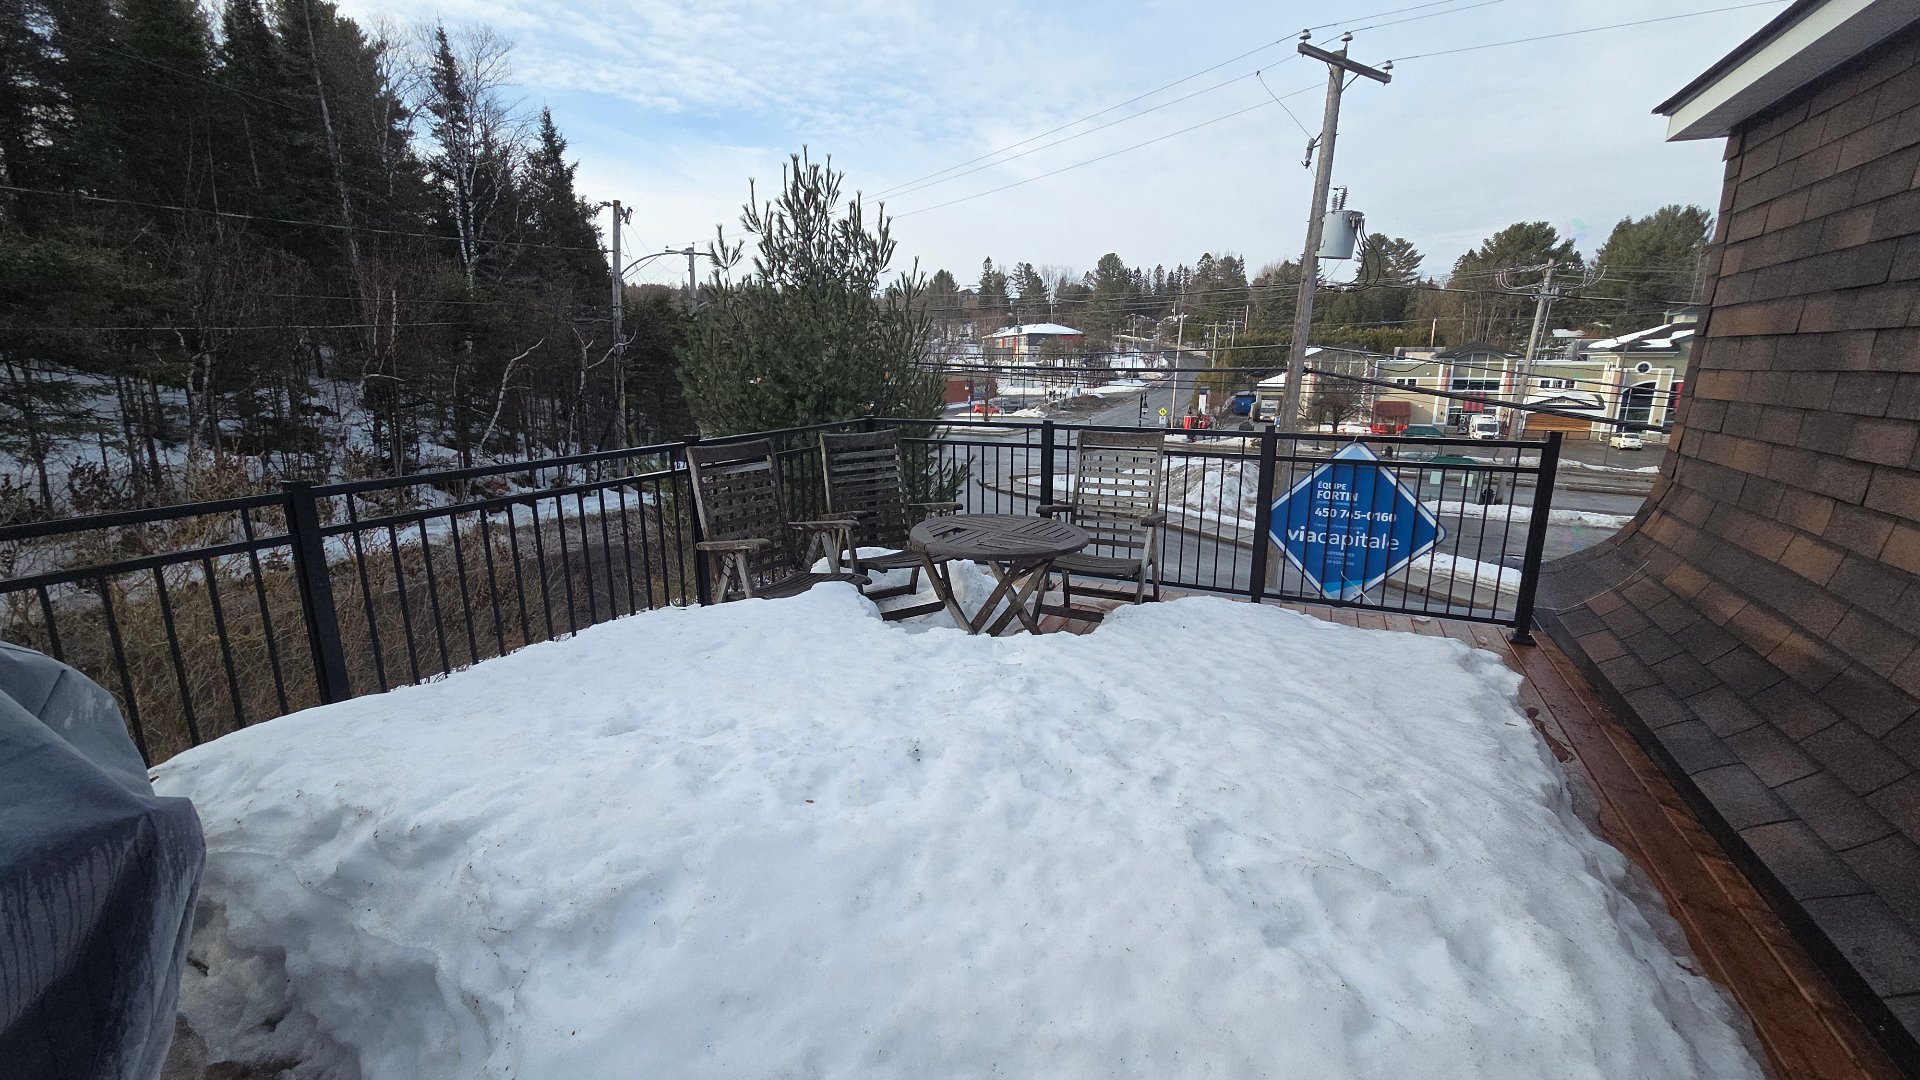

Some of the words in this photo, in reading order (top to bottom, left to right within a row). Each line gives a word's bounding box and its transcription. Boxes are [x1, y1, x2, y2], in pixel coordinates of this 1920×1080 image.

[1316, 490, 1358, 501] FORTIN
[1314, 507, 1337, 518] 450
[1287, 525, 1399, 550] viacapitale
